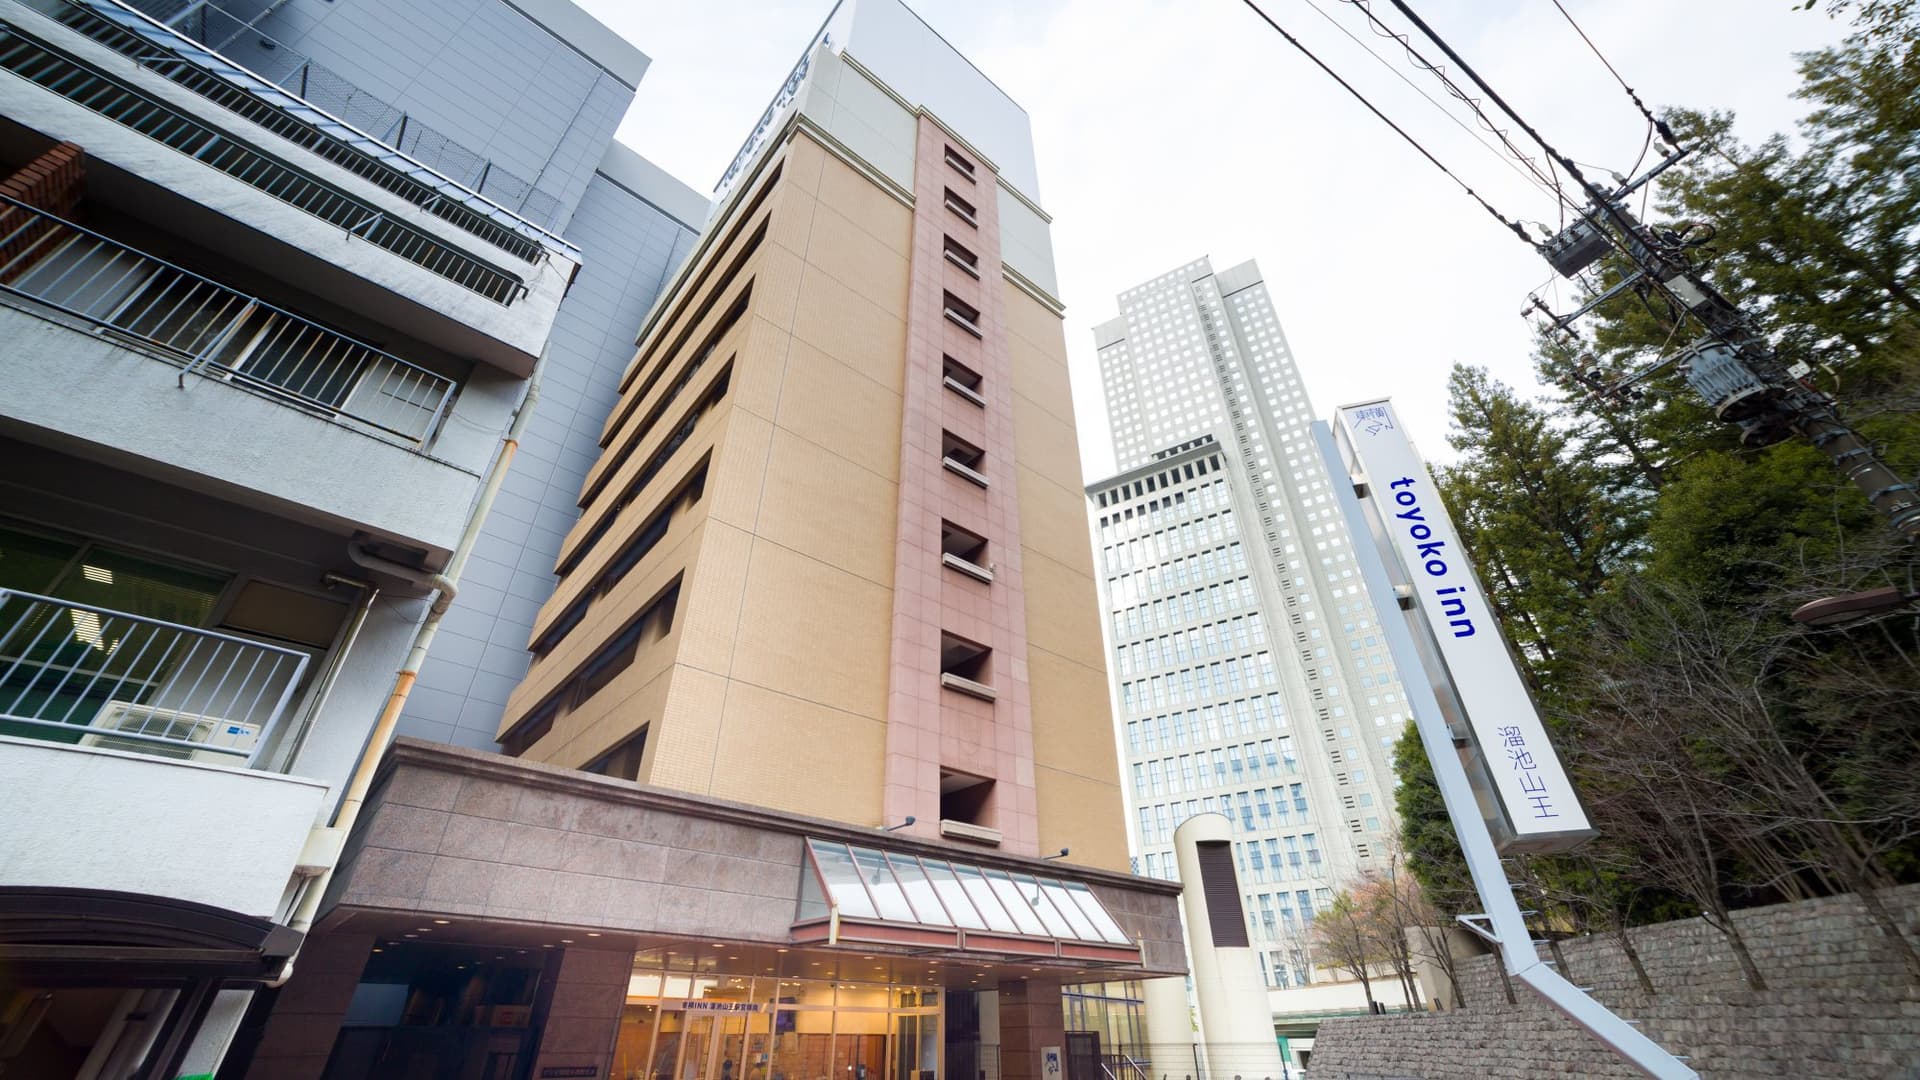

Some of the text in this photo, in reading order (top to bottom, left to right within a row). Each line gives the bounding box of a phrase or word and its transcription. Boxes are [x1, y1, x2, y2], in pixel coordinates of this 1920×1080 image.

[1391, 477, 1476, 638] toyoko inn
[1497, 726, 1560, 819] 溜池山王
